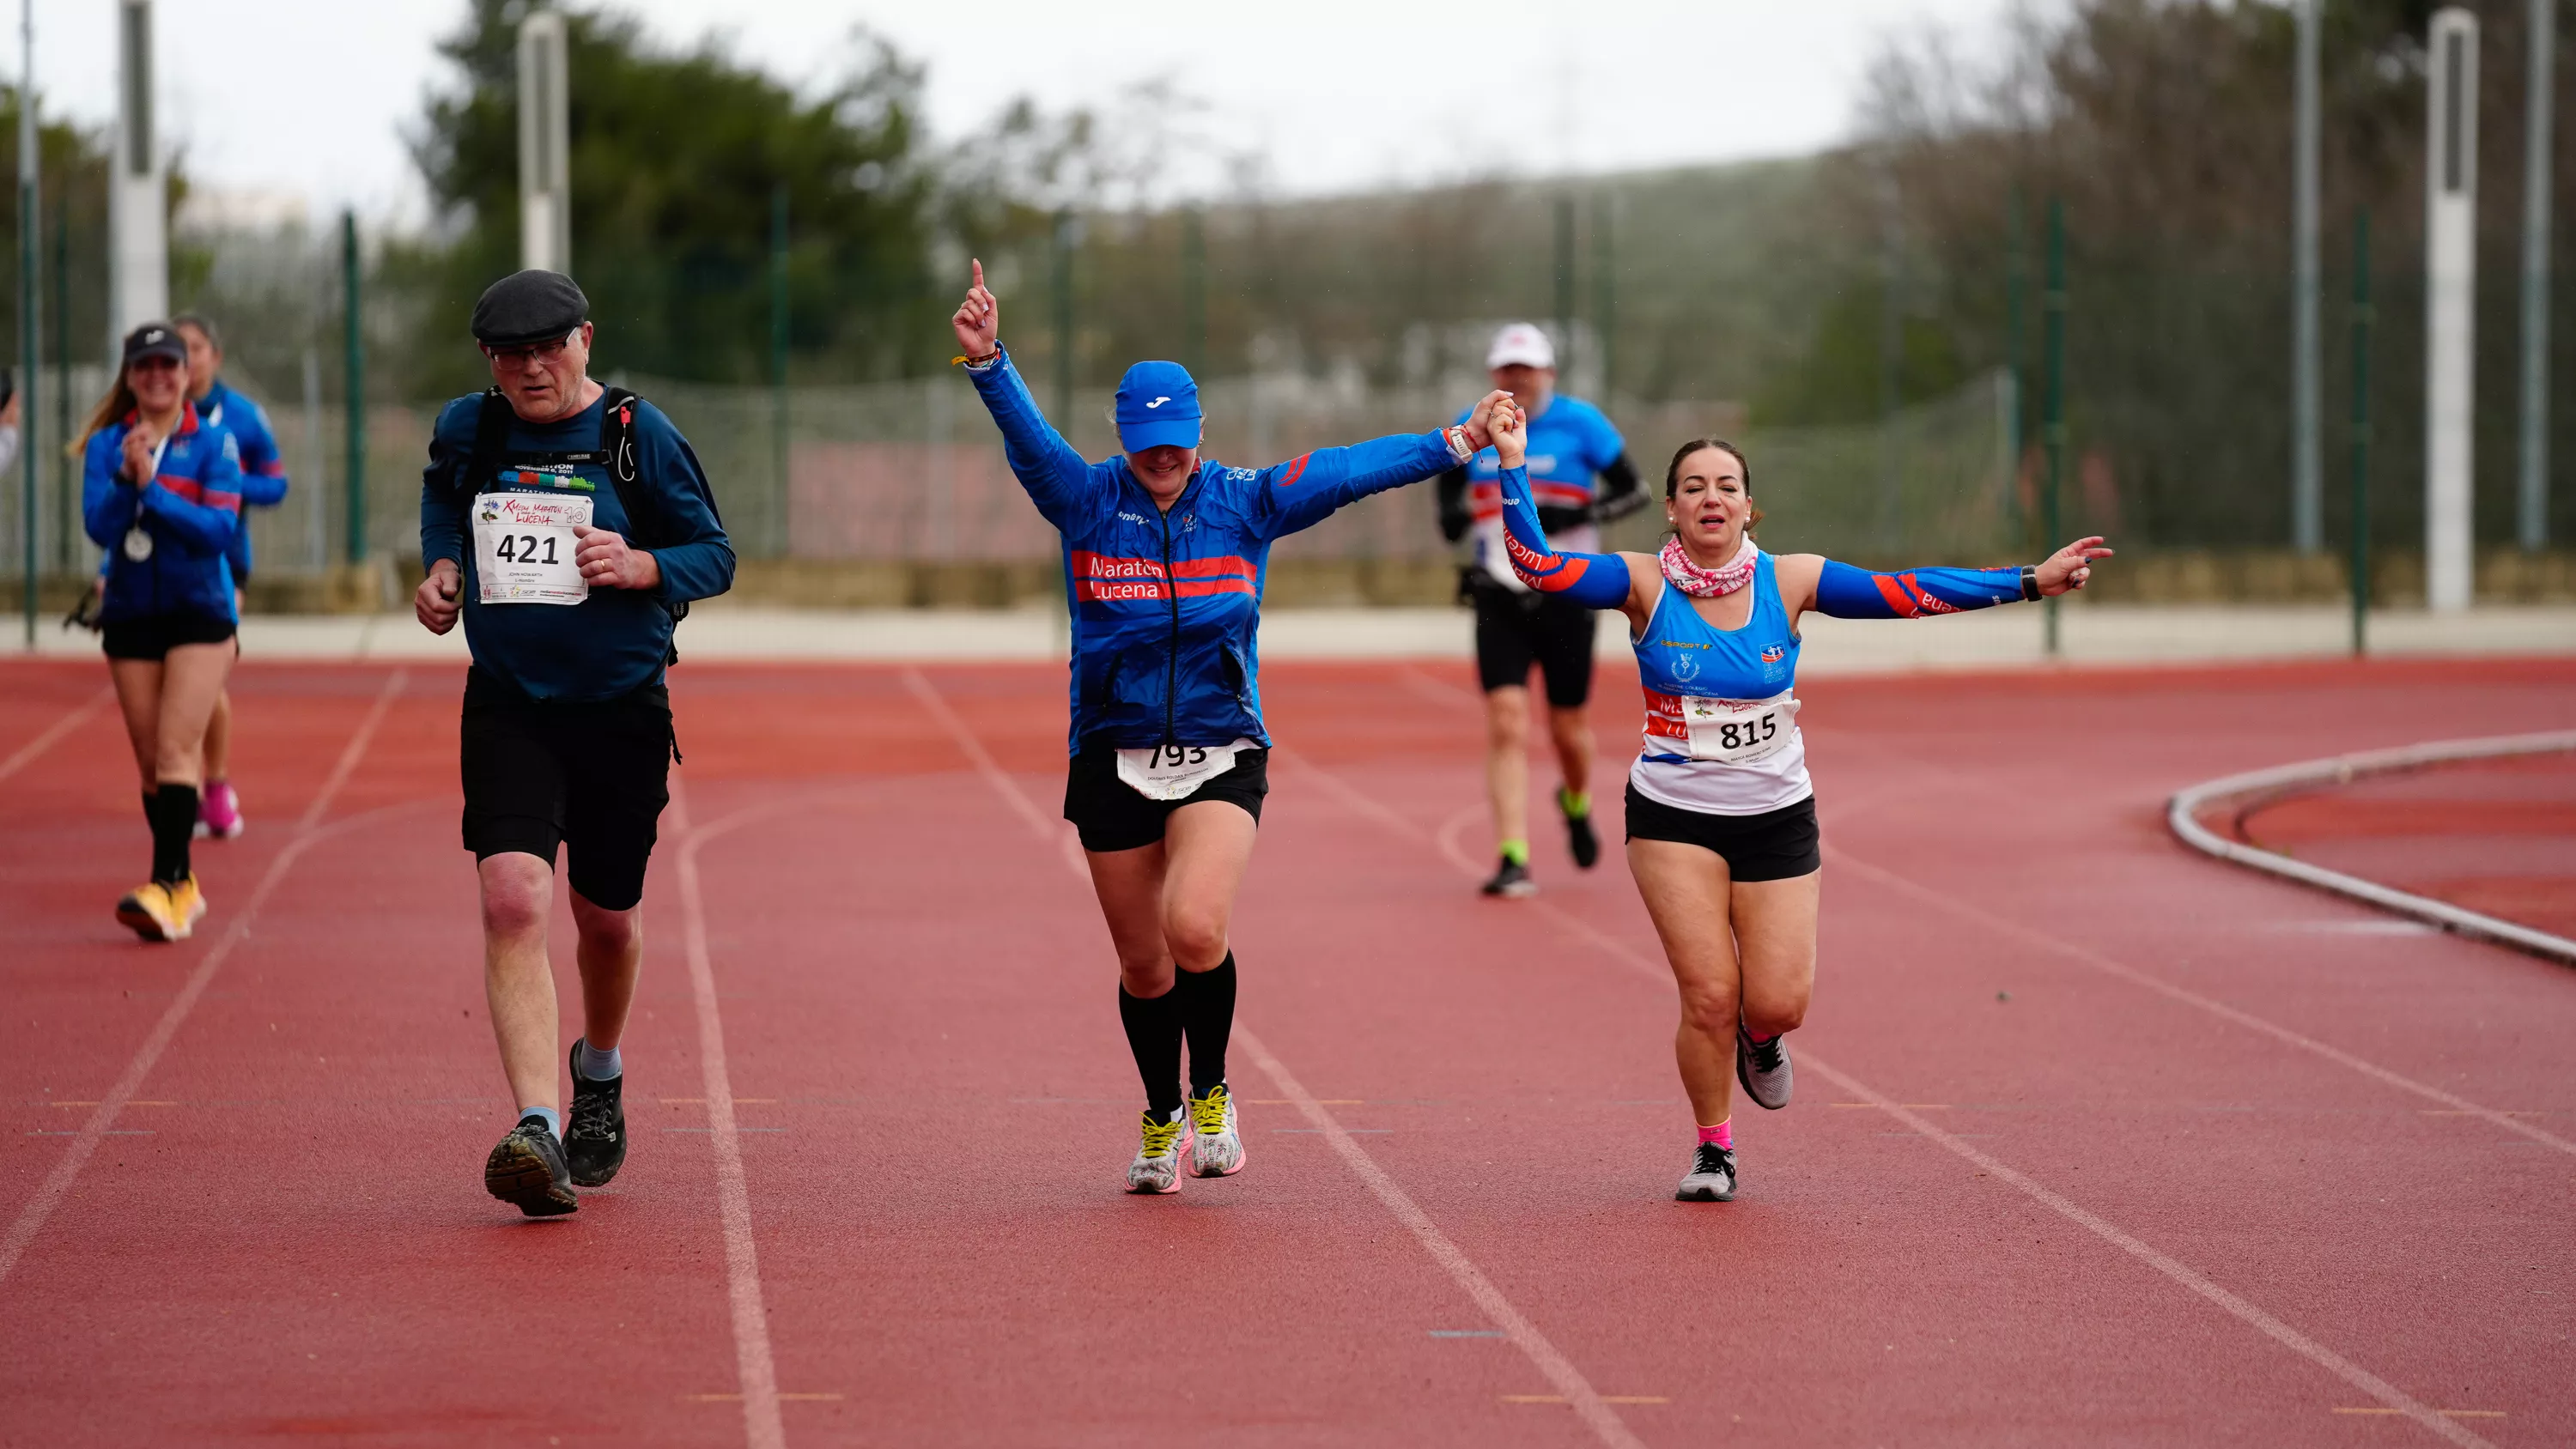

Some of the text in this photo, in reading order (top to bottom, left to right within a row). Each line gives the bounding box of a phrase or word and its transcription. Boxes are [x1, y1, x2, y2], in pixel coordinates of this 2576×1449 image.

[496, 534, 559, 565] 421
[1090, 580, 1159, 600] Lucena
[1720, 712, 1777, 750] 815
[1148, 744, 1207, 769] 793
